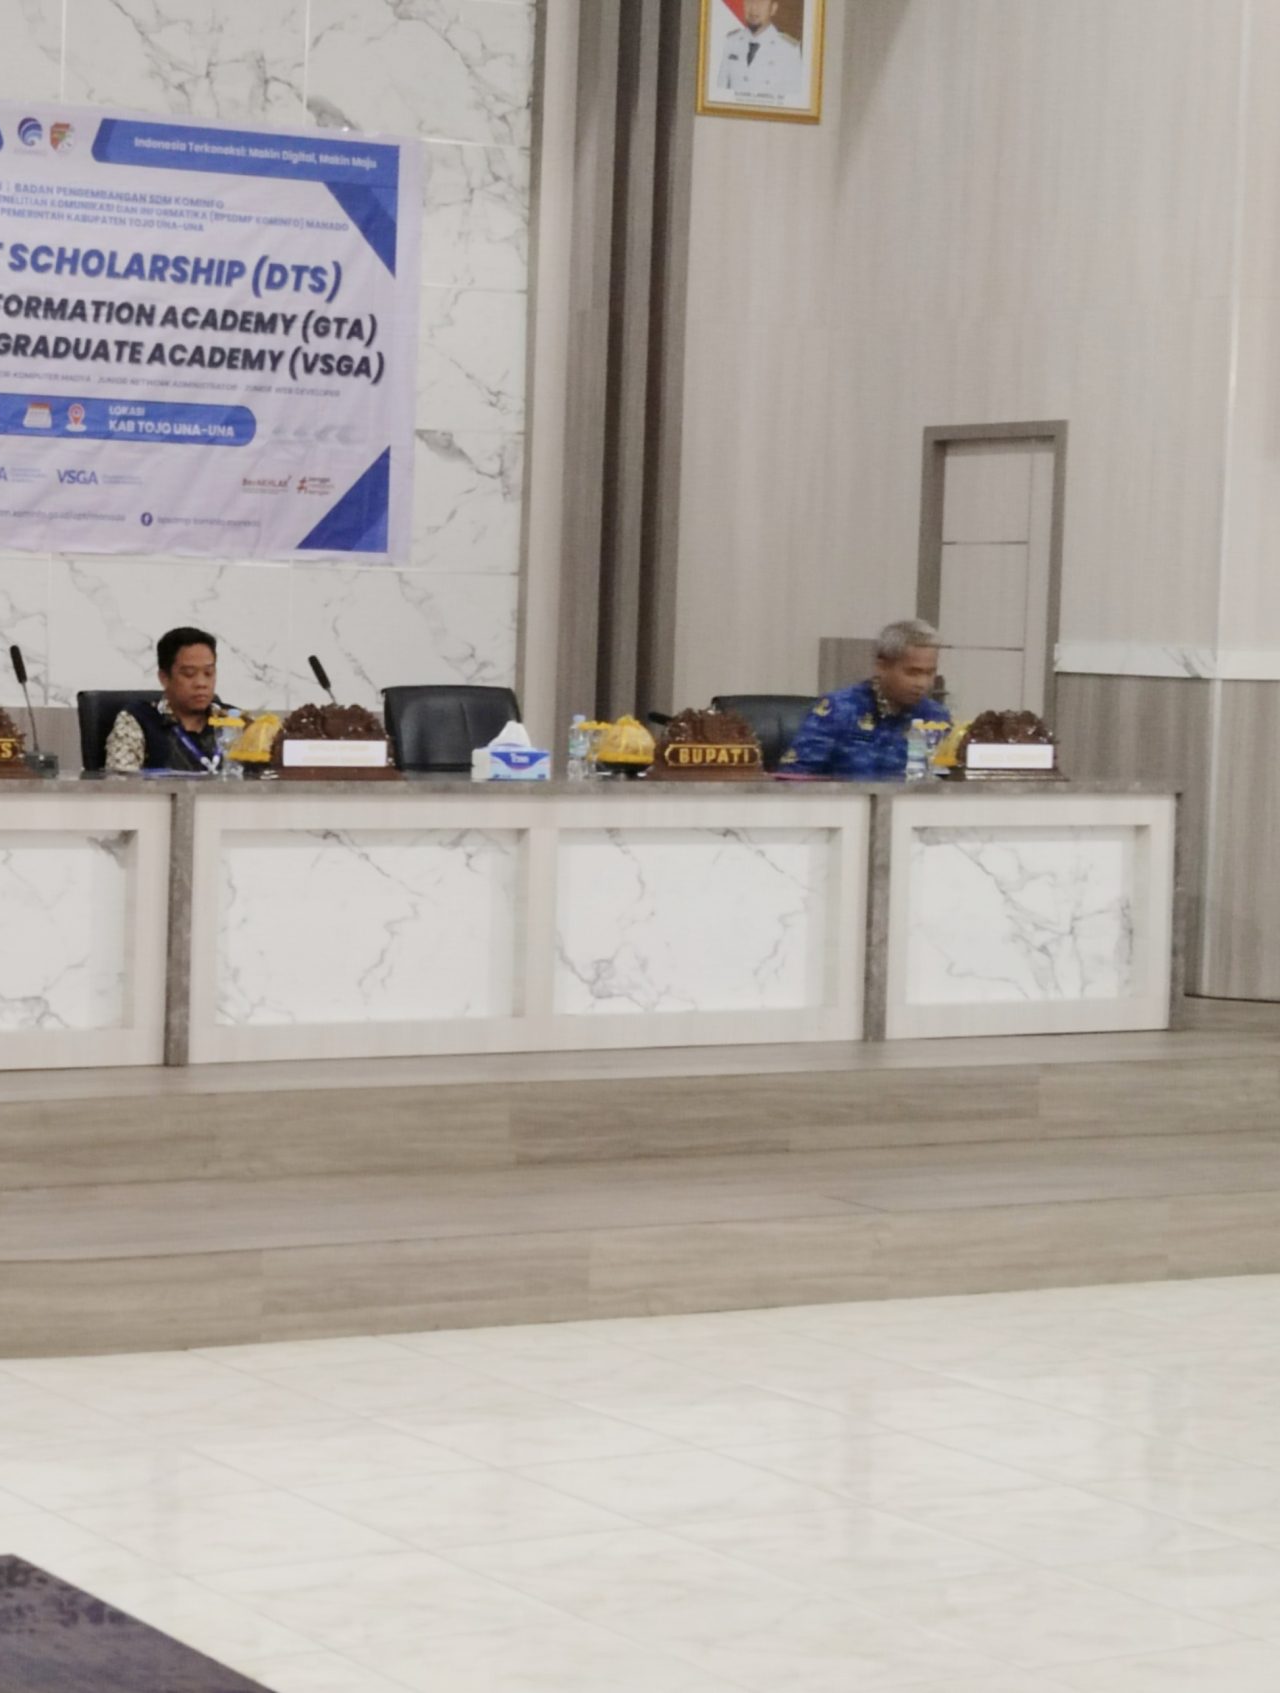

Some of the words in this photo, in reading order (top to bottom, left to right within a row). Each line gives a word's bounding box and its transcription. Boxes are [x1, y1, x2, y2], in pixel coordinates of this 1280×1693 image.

[134, 137, 186, 152] Indonesia
[249, 147, 280, 160] Makin
[282, 150, 317, 165] Digital,
[319, 154, 350, 167] Makin
[352, 156, 378, 170] Maju
[14, 182, 54, 195] BADAN
[56, 187, 147, 203] PENGEMBANGAN
[149, 195, 172, 205] SDM
[174, 197, 224, 209] KOMINFO
[0, 207, 65, 221] PEMERINTAH
[66, 213, 126, 226] KABUPATEN
[129, 218, 154, 228] TOJO
[156, 220, 204, 232] UNA-UNA
[50, 198, 114, 211] KOMUNIKASI
[306, 220, 349, 231] MANADO
[8, 243, 247, 287] SCHOLARSHIP
[252, 255, 342, 304] (DTS)
[160, 305, 298, 336] ACADEMY
[302, 309, 377, 347] (GTA)
[146, 342, 285, 373] ACADEMY
[289, 345, 385, 386] (VSGA)
[108, 405, 146, 416] LOKASI
[108, 419, 135, 433] KAB
[137, 420, 172, 434] TOJO
[173, 423, 235, 437] UNA-UNA
[57, 468, 99, 485] VSGA
[679, 748, 750, 764] BUPATI
